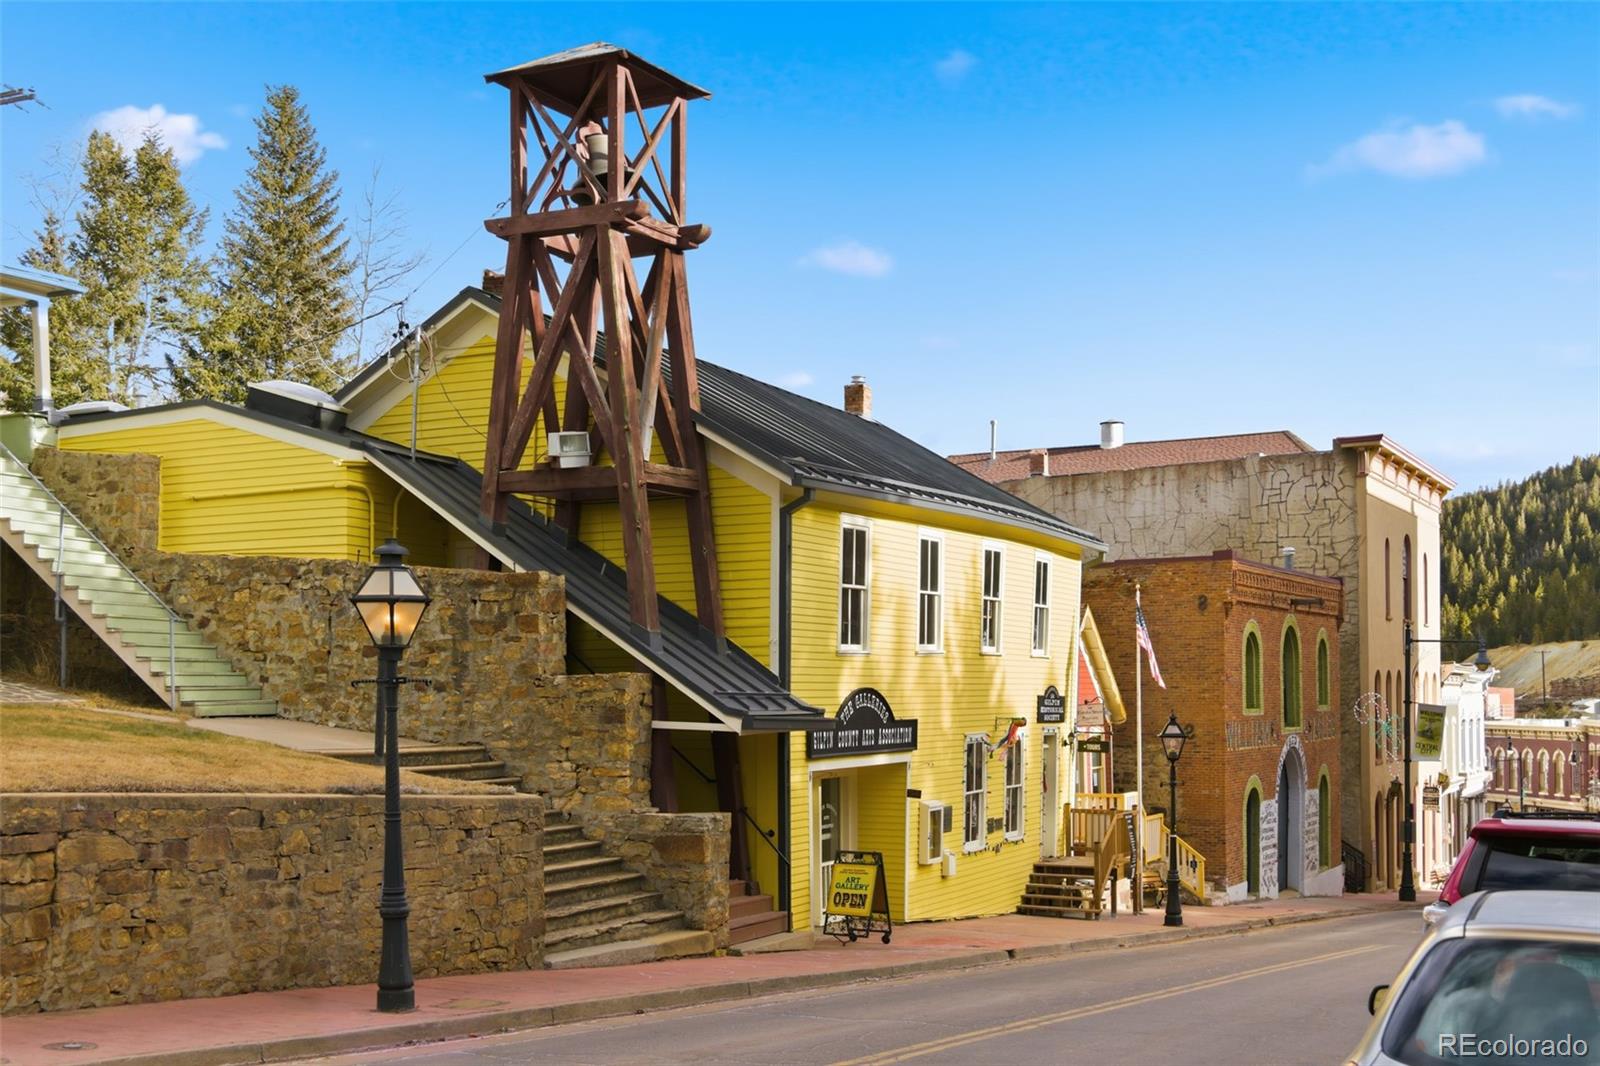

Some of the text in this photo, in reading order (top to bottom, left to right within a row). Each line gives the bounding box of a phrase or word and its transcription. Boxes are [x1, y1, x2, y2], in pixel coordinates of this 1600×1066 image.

[840, 700, 854, 725] THE
[813, 726, 913, 750] GILPIN COUNTY ARTS ASSOCIATION
[835, 882, 870, 891] GALLERY
[845, 876, 861, 884] ART
[833, 891, 868, 909] OPEN
